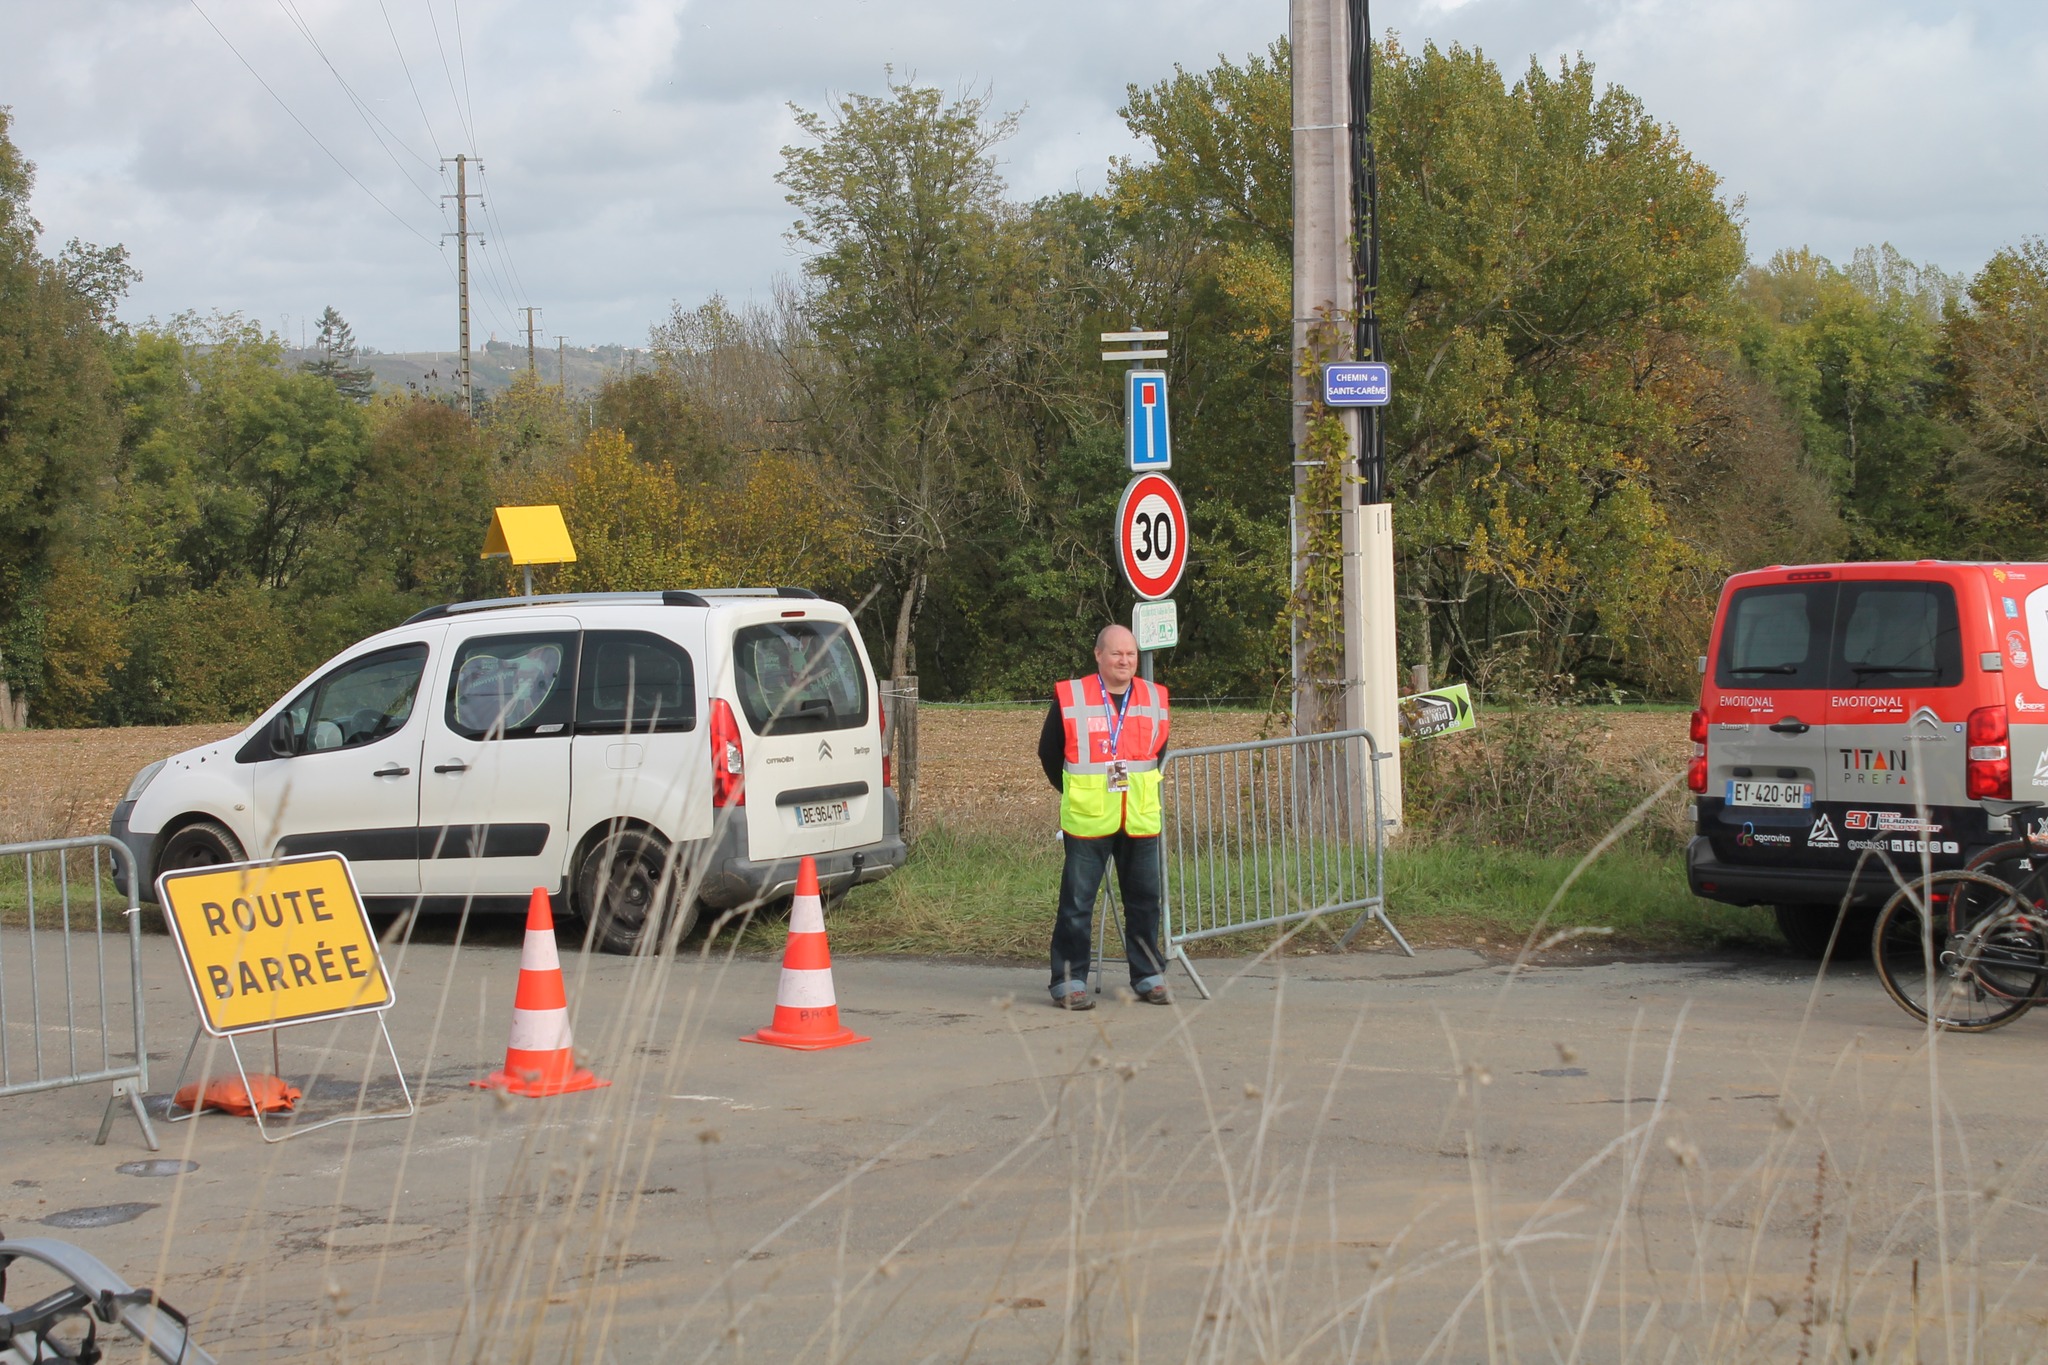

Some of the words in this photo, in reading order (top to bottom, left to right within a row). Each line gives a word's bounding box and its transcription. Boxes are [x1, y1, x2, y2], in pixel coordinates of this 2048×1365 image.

[1336, 373, 1368, 382] CHEMIN
[1370, 374, 1379, 382] de
[1328, 385, 1387, 395] SAINTE-CARÊME
[1134, 511, 1172, 562] 30
[1719, 695, 1774, 707] EMOTIONAL
[1831, 696, 1904, 708] EMOTIONAL
[1840, 748, 1907, 771] TITAN
[1844, 773, 1907, 785] PREFA
[1734, 783, 1801, 804] EY-420-GH
[802, 804, 844, 825] BE-964-TP
[1845, 810, 1880, 830] 31
[201, 887, 333, 937] ROUTE
[207, 941, 368, 1000] BARRÉE
